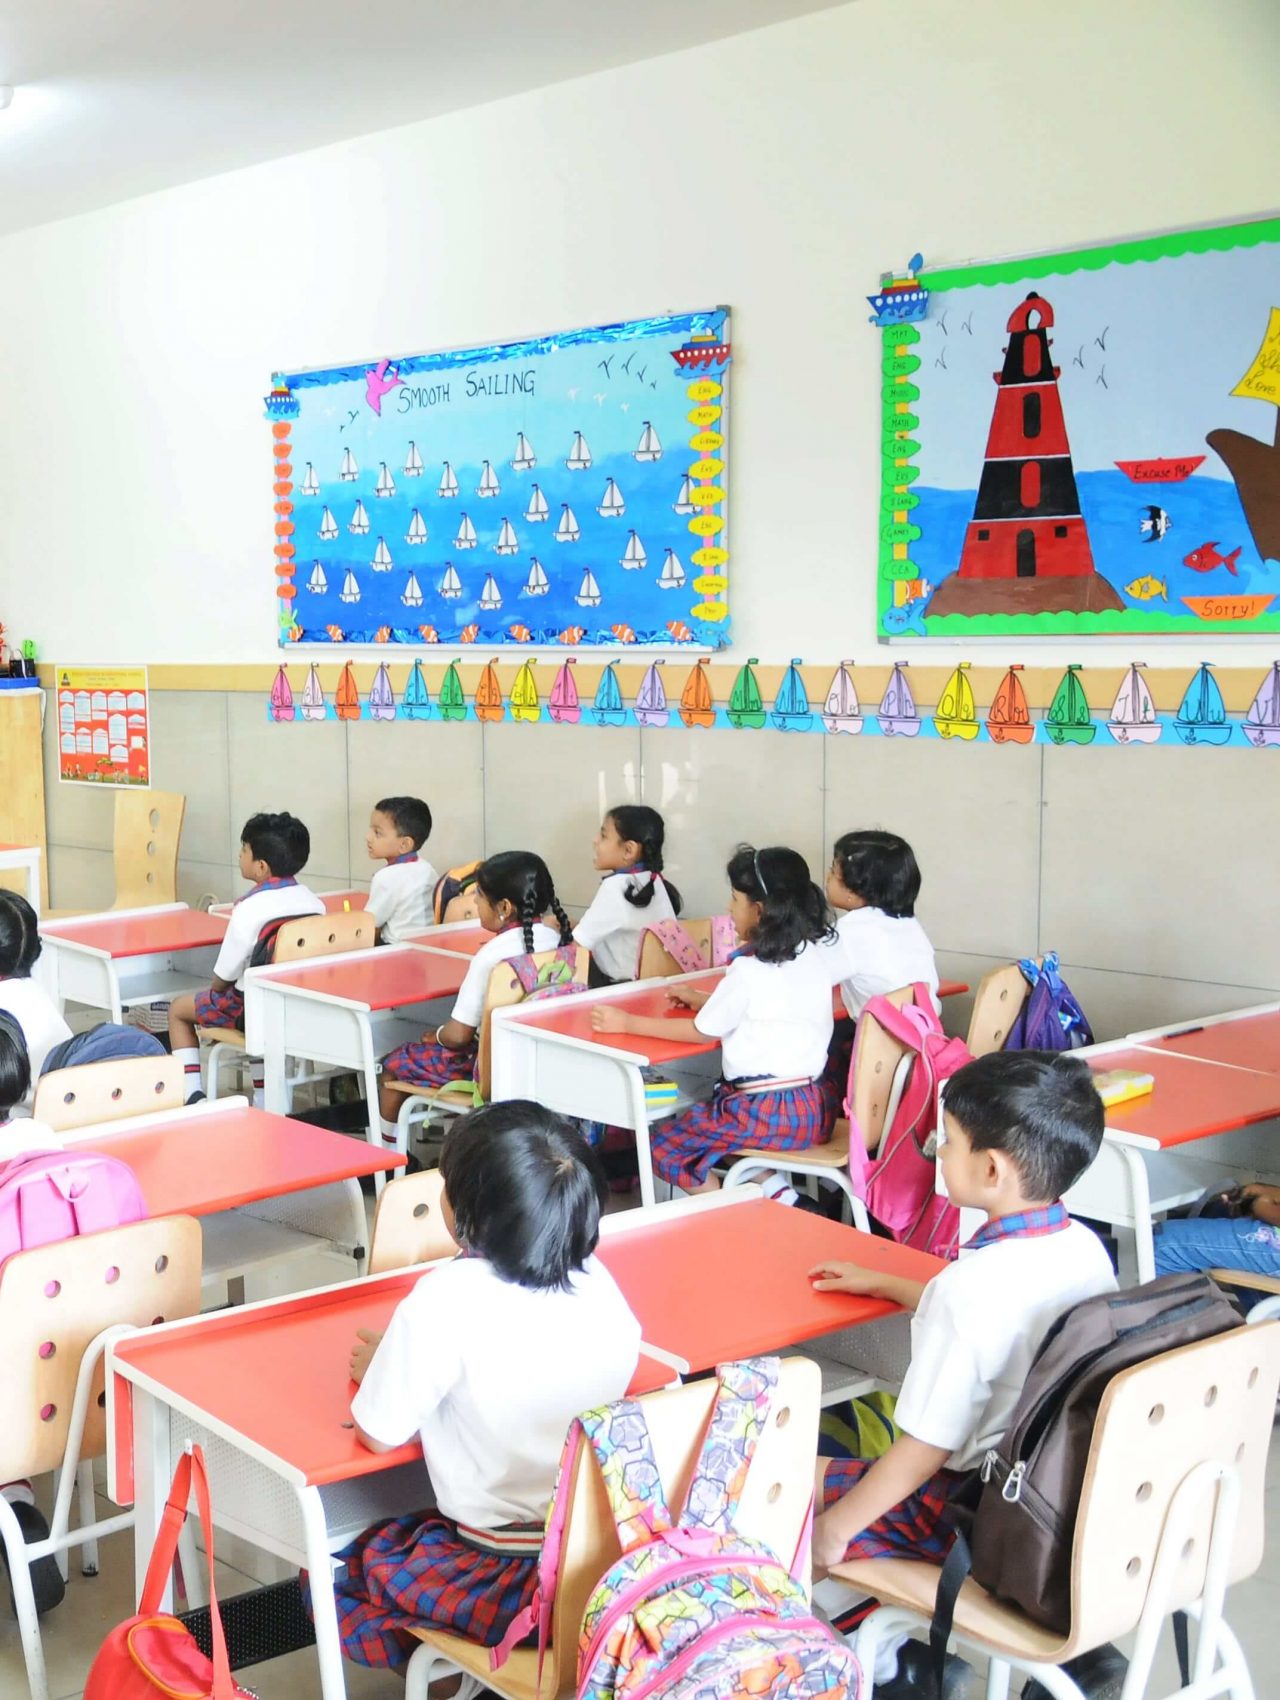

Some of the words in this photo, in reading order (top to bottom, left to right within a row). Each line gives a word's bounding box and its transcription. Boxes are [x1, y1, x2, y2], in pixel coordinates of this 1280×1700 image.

[892, 361, 907, 370] ENG
[397, 383, 451, 413] SMOOTH
[466, 370, 536, 397] SAILING
[891, 418, 909, 427] MATH
[1133, 464, 1170, 480] Excuse
[1201, 599, 1256, 619] Sorry!
[884, 690, 897, 714] P
[941, 694, 956, 719] Q
[993, 695, 1008, 722] R
